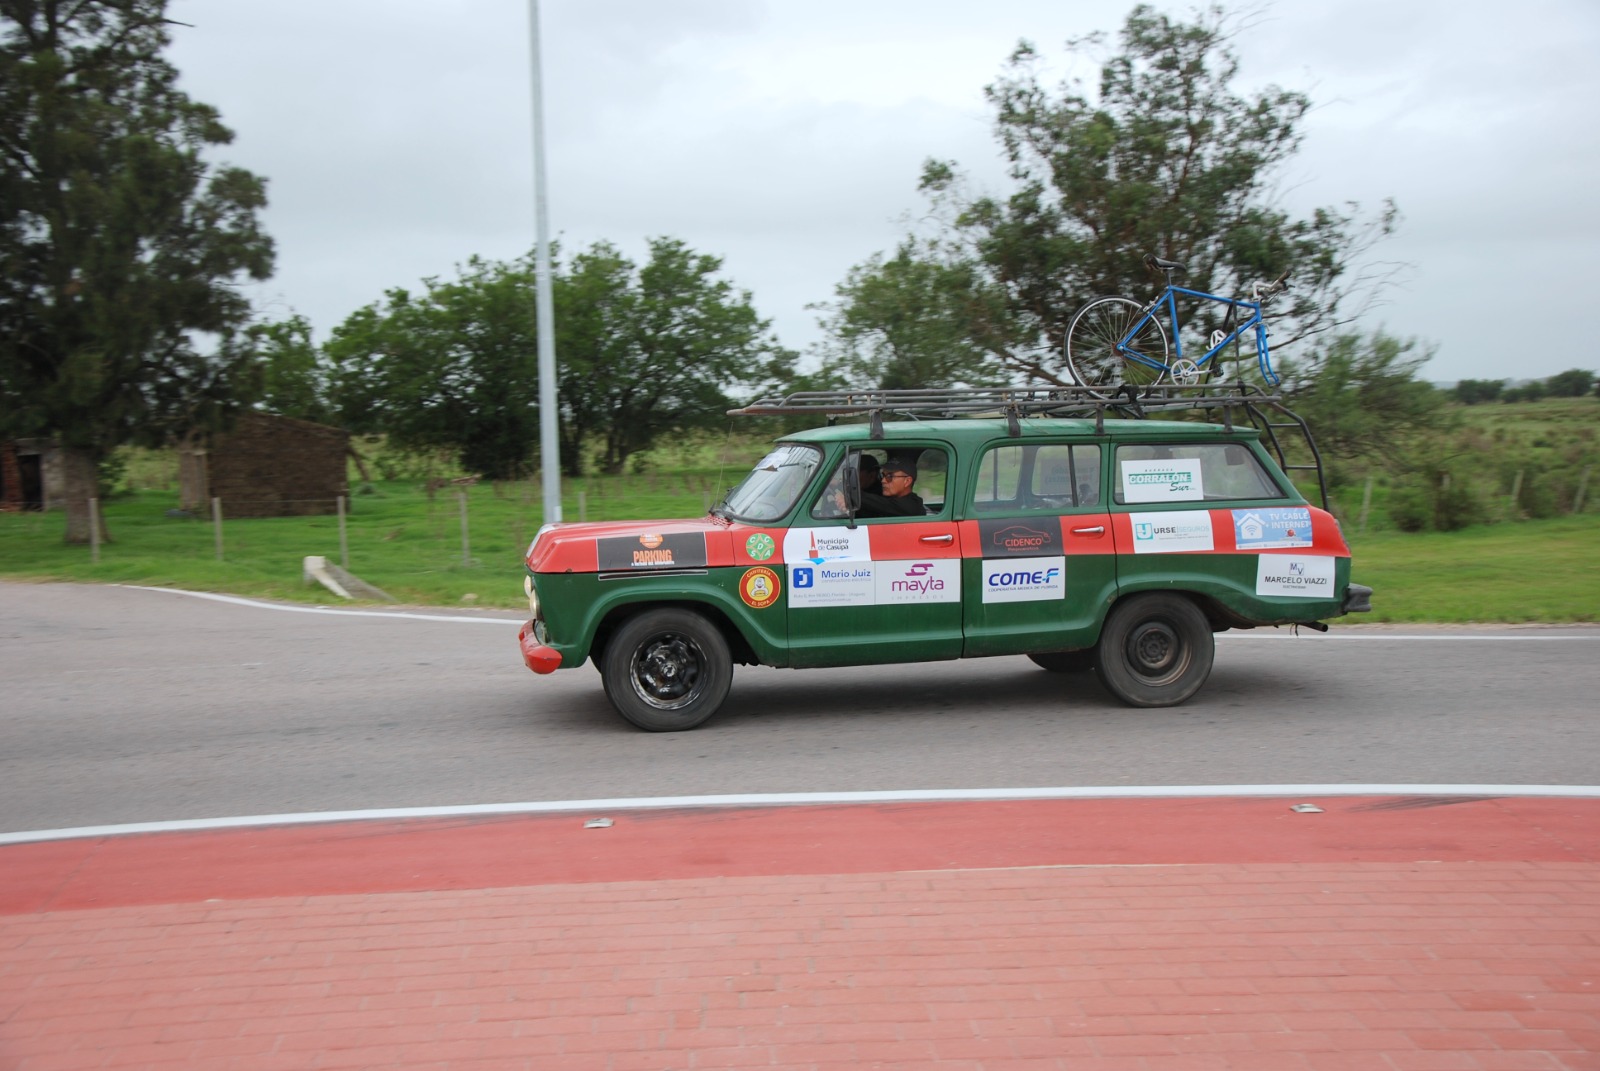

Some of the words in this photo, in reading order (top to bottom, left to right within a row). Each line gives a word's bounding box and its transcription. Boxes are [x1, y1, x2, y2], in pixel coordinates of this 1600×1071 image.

[1169, 482, 1190, 492] Sur
[1282, 512, 1309, 520] CABLE
[1271, 520, 1309, 529] INTERNET
[1153, 526, 1176, 534] URSE
[817, 537, 849, 546] Municipio
[1005, 538, 1042, 547] CIDENCO
[633, 549, 673, 564] PARKING
[821, 570, 850, 579] Mario
[852, 569, 871, 578] Juiz
[1264, 575, 1303, 584] MARCELO
[1304, 577, 1327, 585] VIAZZI
[891, 575, 945, 595] mayta
